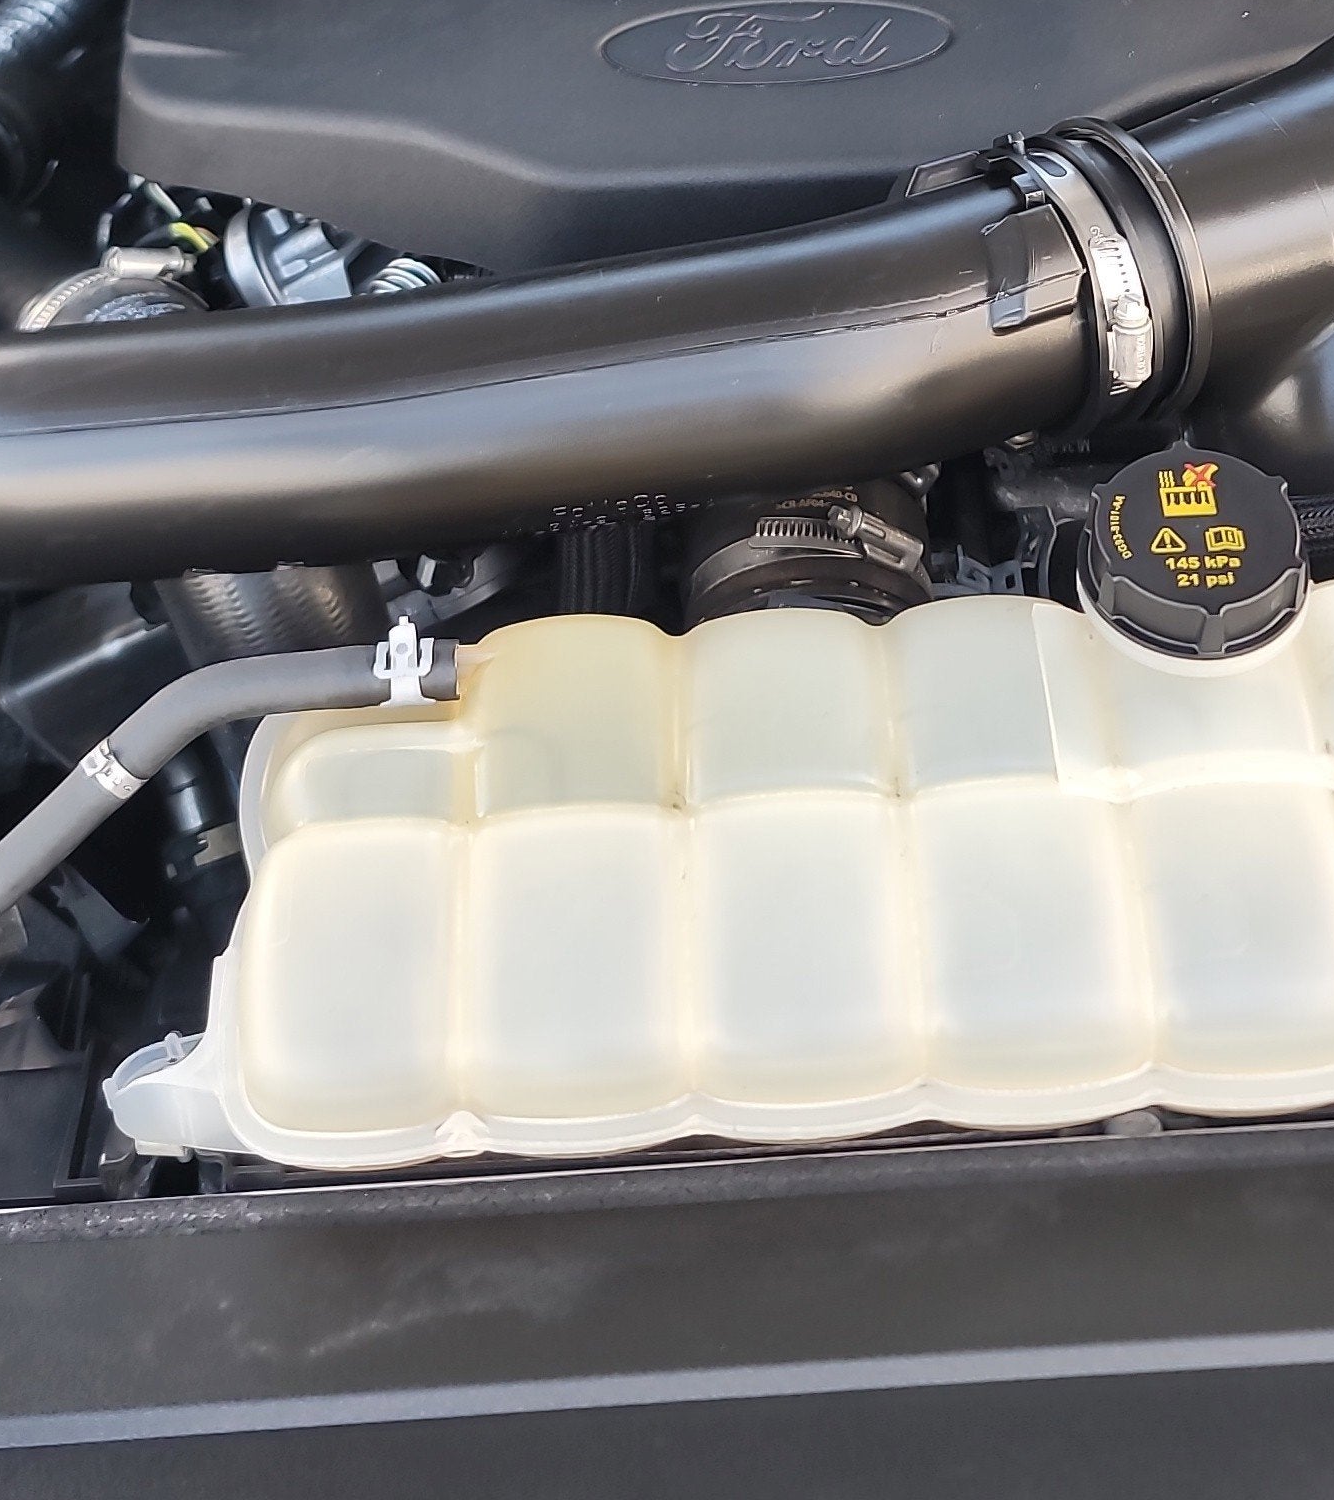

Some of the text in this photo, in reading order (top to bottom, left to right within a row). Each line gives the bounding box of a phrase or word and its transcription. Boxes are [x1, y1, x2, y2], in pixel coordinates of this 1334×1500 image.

[666, 6, 893, 74] Ford
[1165, 555, 1241, 571] 145 kPa
[1177, 571, 1236, 589] 21 psi
